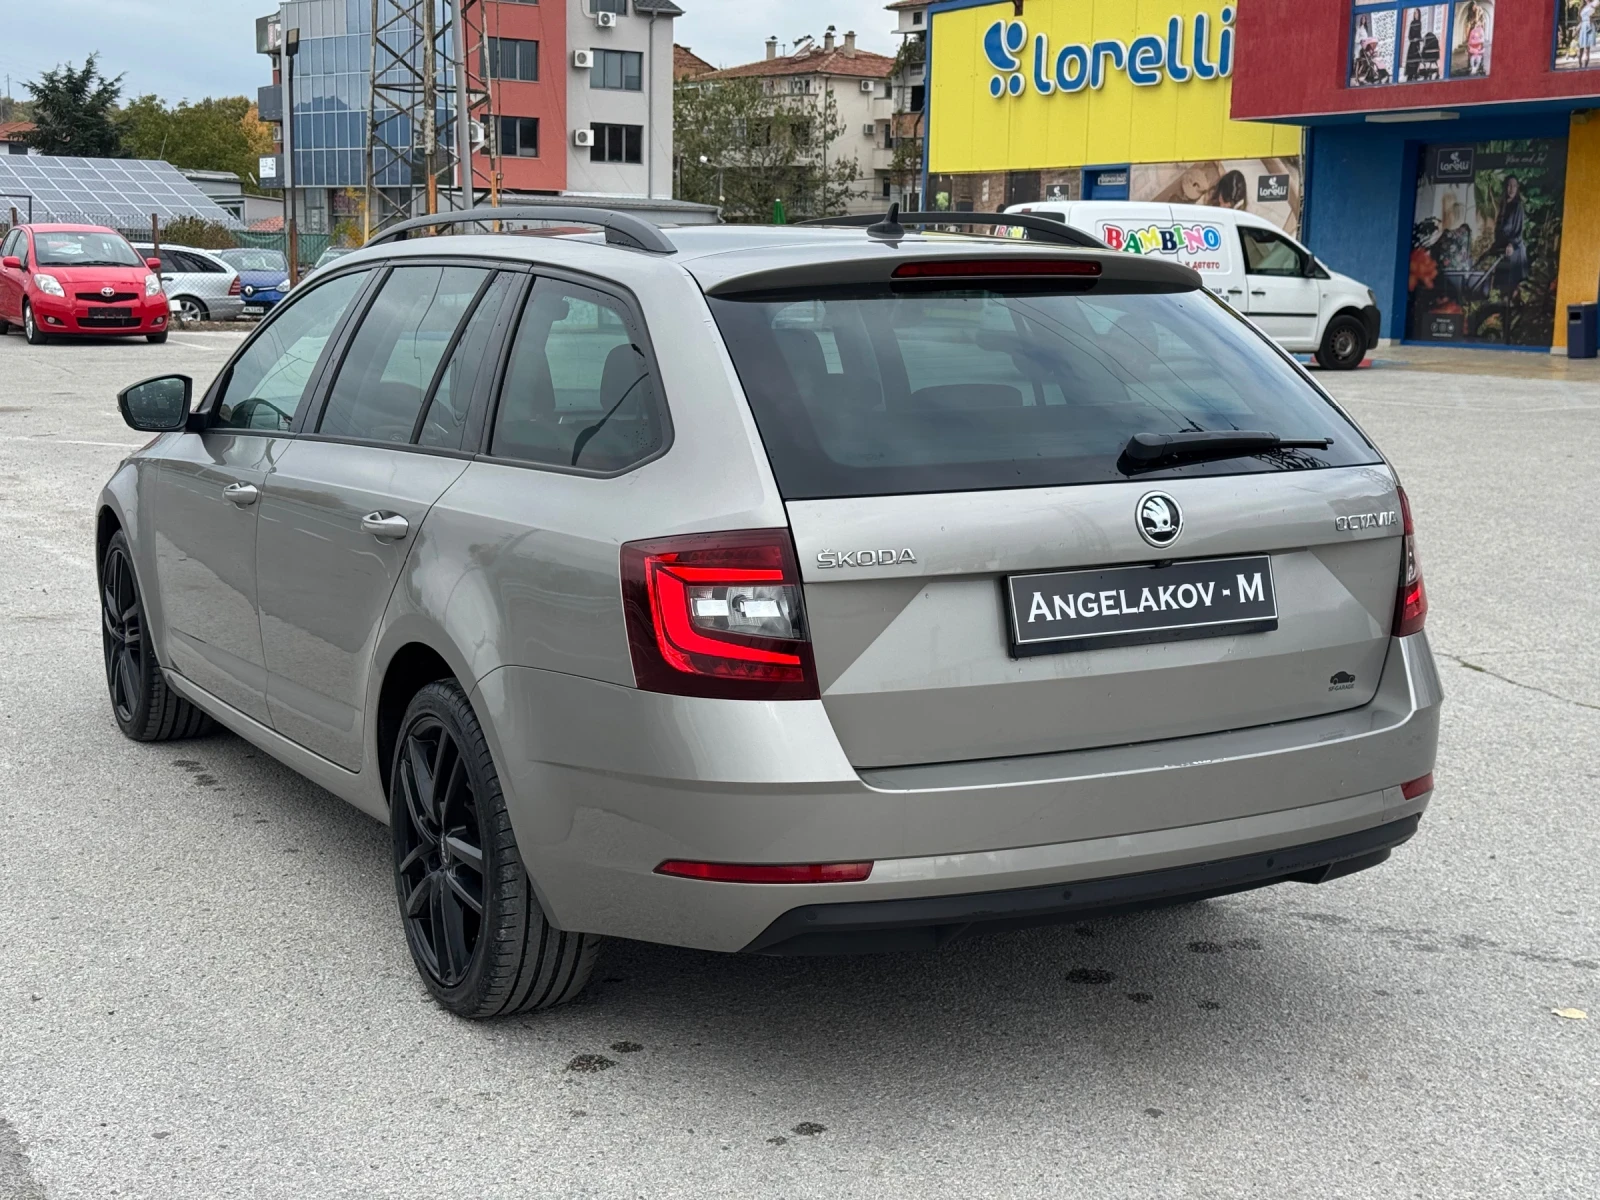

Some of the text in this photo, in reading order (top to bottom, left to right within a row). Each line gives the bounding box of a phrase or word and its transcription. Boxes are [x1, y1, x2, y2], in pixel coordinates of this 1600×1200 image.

[1034, 6, 1236, 95] lorelli
[1103, 223, 1221, 254] BAMBINO
[1335, 511, 1398, 531] OCTAVIA
[817, 548, 917, 569] ŠKODA
[1236, 572, 1265, 603] M
